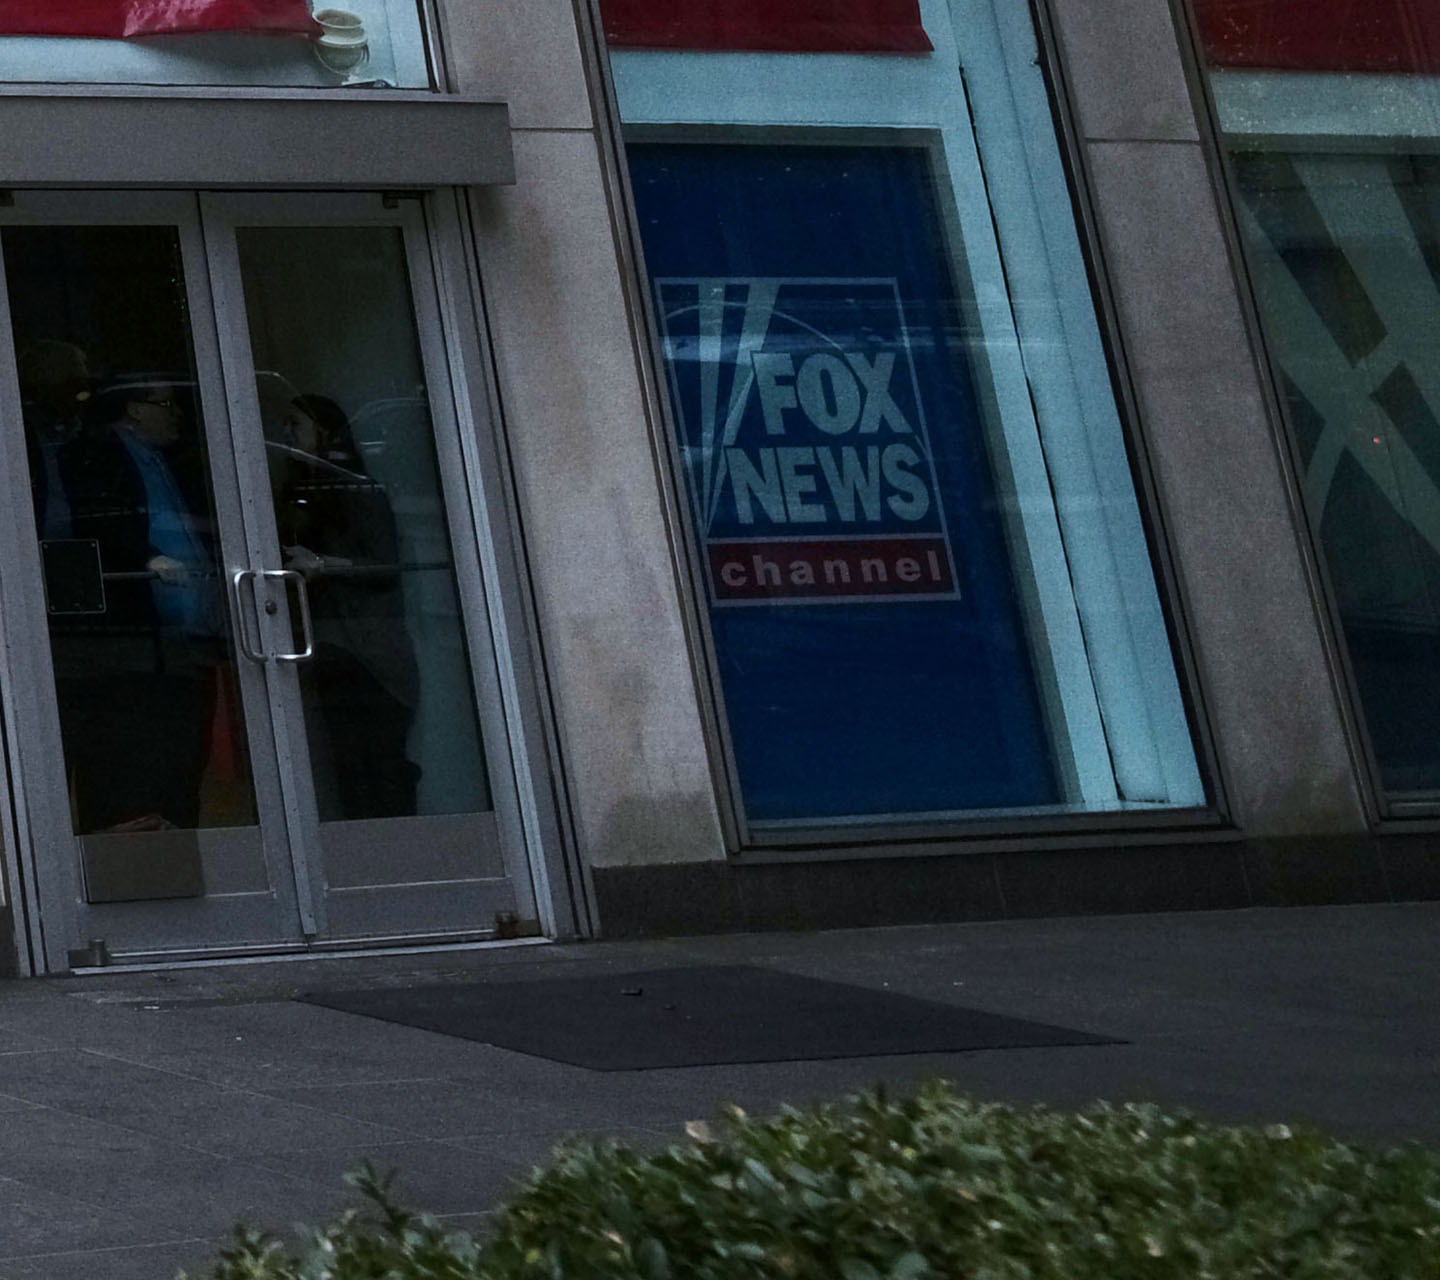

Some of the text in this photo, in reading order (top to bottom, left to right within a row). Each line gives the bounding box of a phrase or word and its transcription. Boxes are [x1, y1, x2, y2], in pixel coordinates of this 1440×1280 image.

[751, 351, 913, 437] FOX
[725, 443, 929, 525] NEWS
[721, 550, 943, 587] channel
